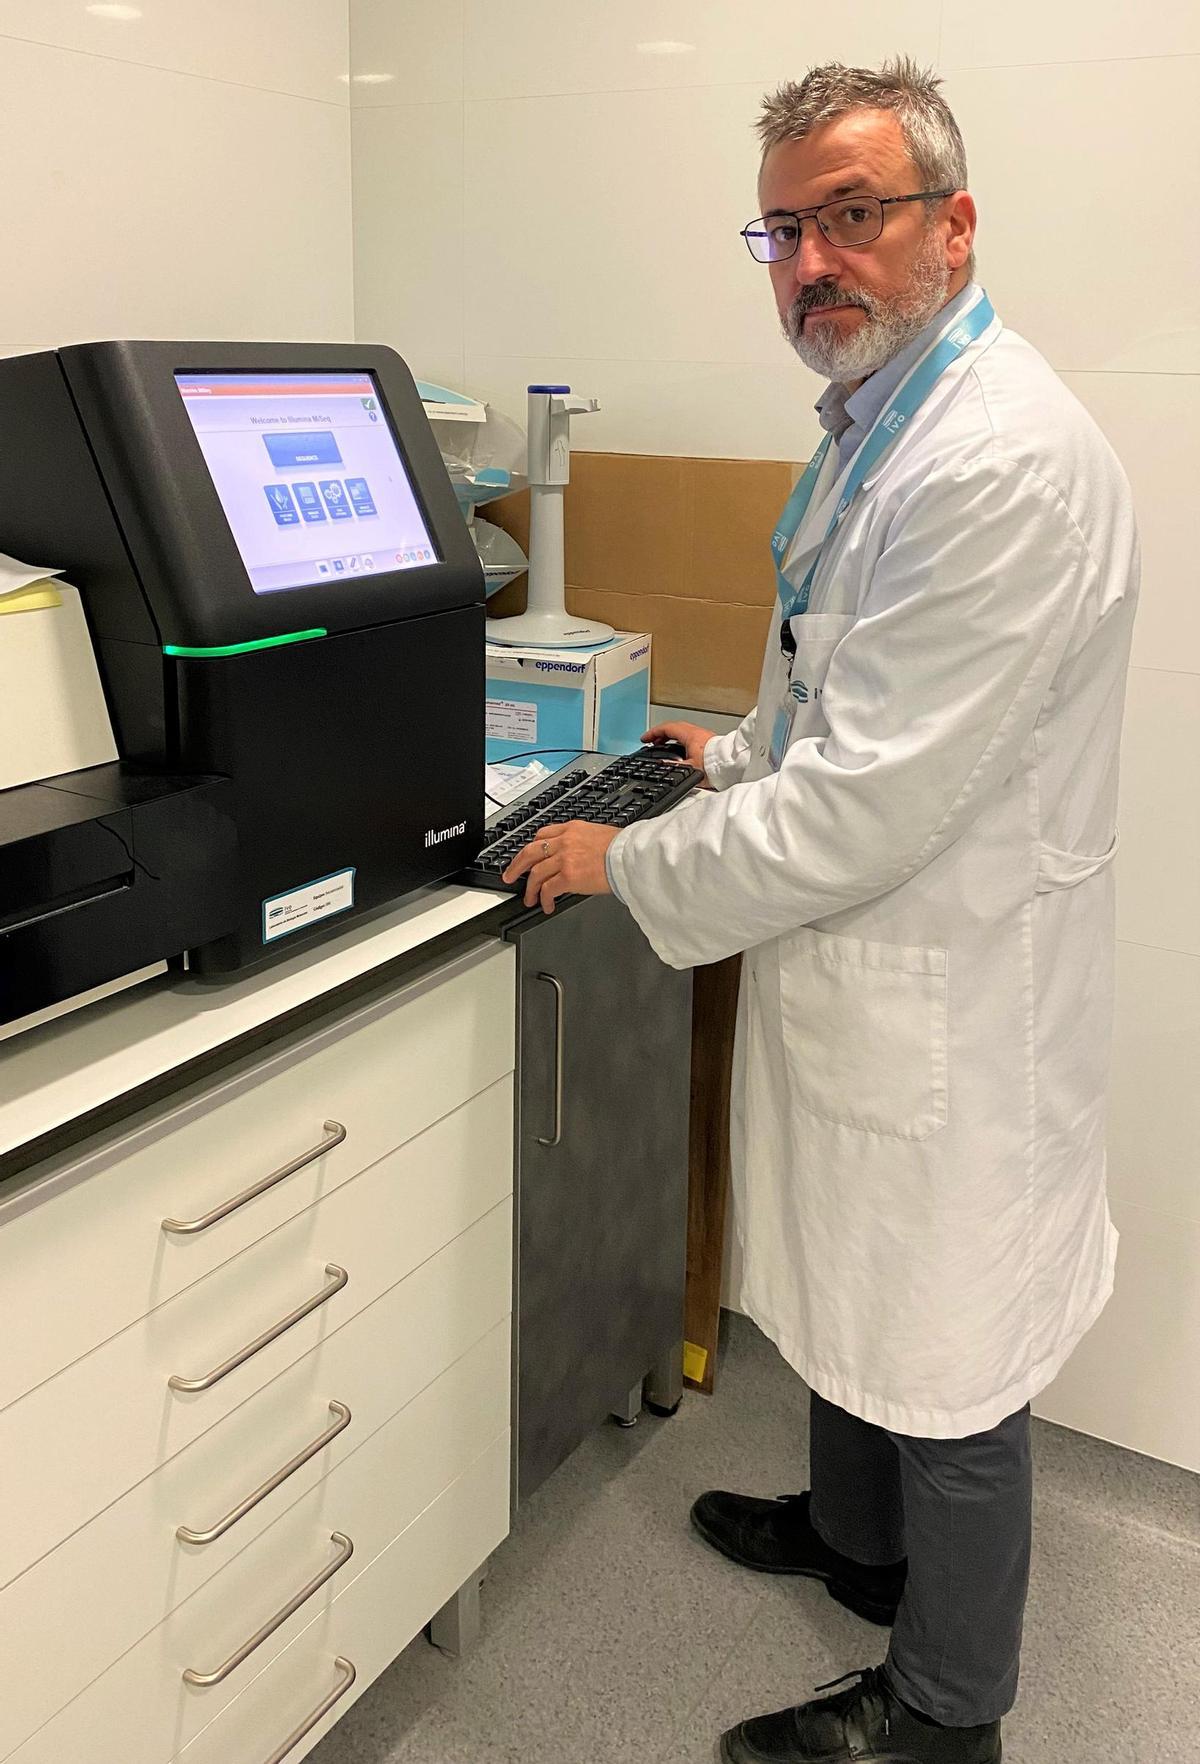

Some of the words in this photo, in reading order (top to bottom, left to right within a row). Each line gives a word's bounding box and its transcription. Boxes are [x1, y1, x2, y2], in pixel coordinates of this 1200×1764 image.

[250, 416, 279, 424] Welcome
[312, 416, 332, 424] MiSeq
[535, 661, 586, 673] eppendorf
[424, 821, 465, 848] illumina
